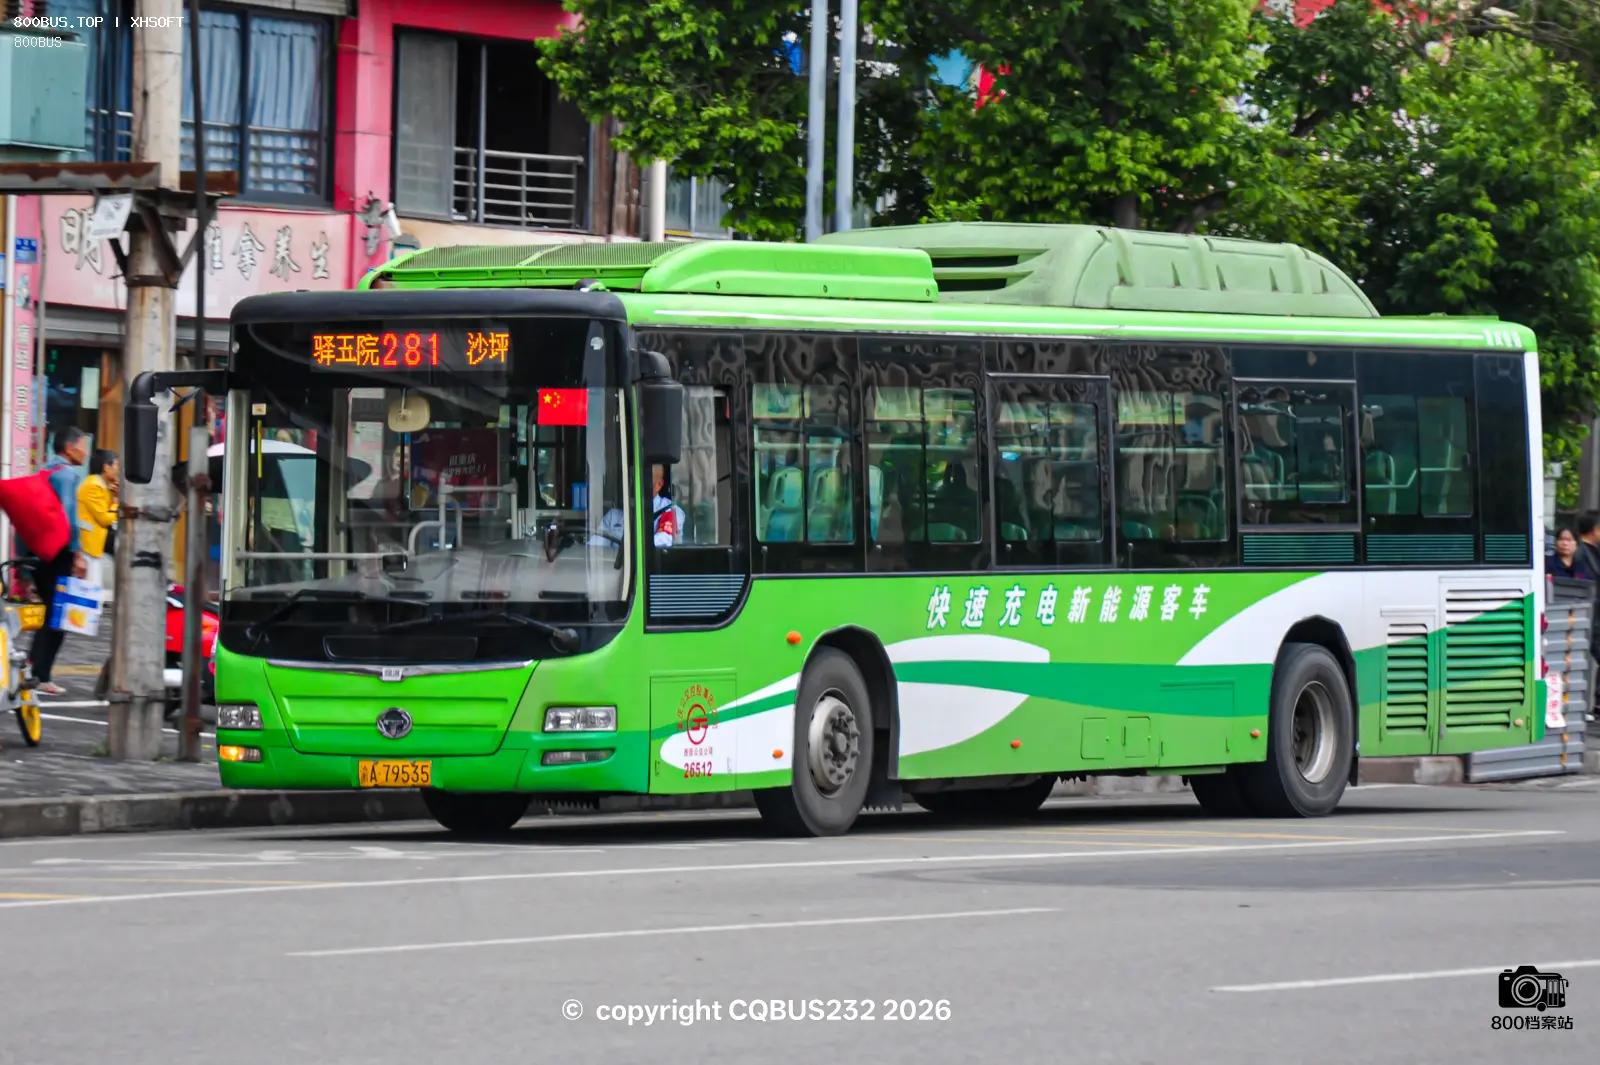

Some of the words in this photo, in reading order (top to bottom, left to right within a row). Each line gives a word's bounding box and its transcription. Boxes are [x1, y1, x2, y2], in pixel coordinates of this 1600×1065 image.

[382, 332, 439, 367] 281
[466, 332, 510, 366] 沙坪
[926, 582, 1212, 630] 快速充电新能源客车
[684, 760, 713, 779] 26512
